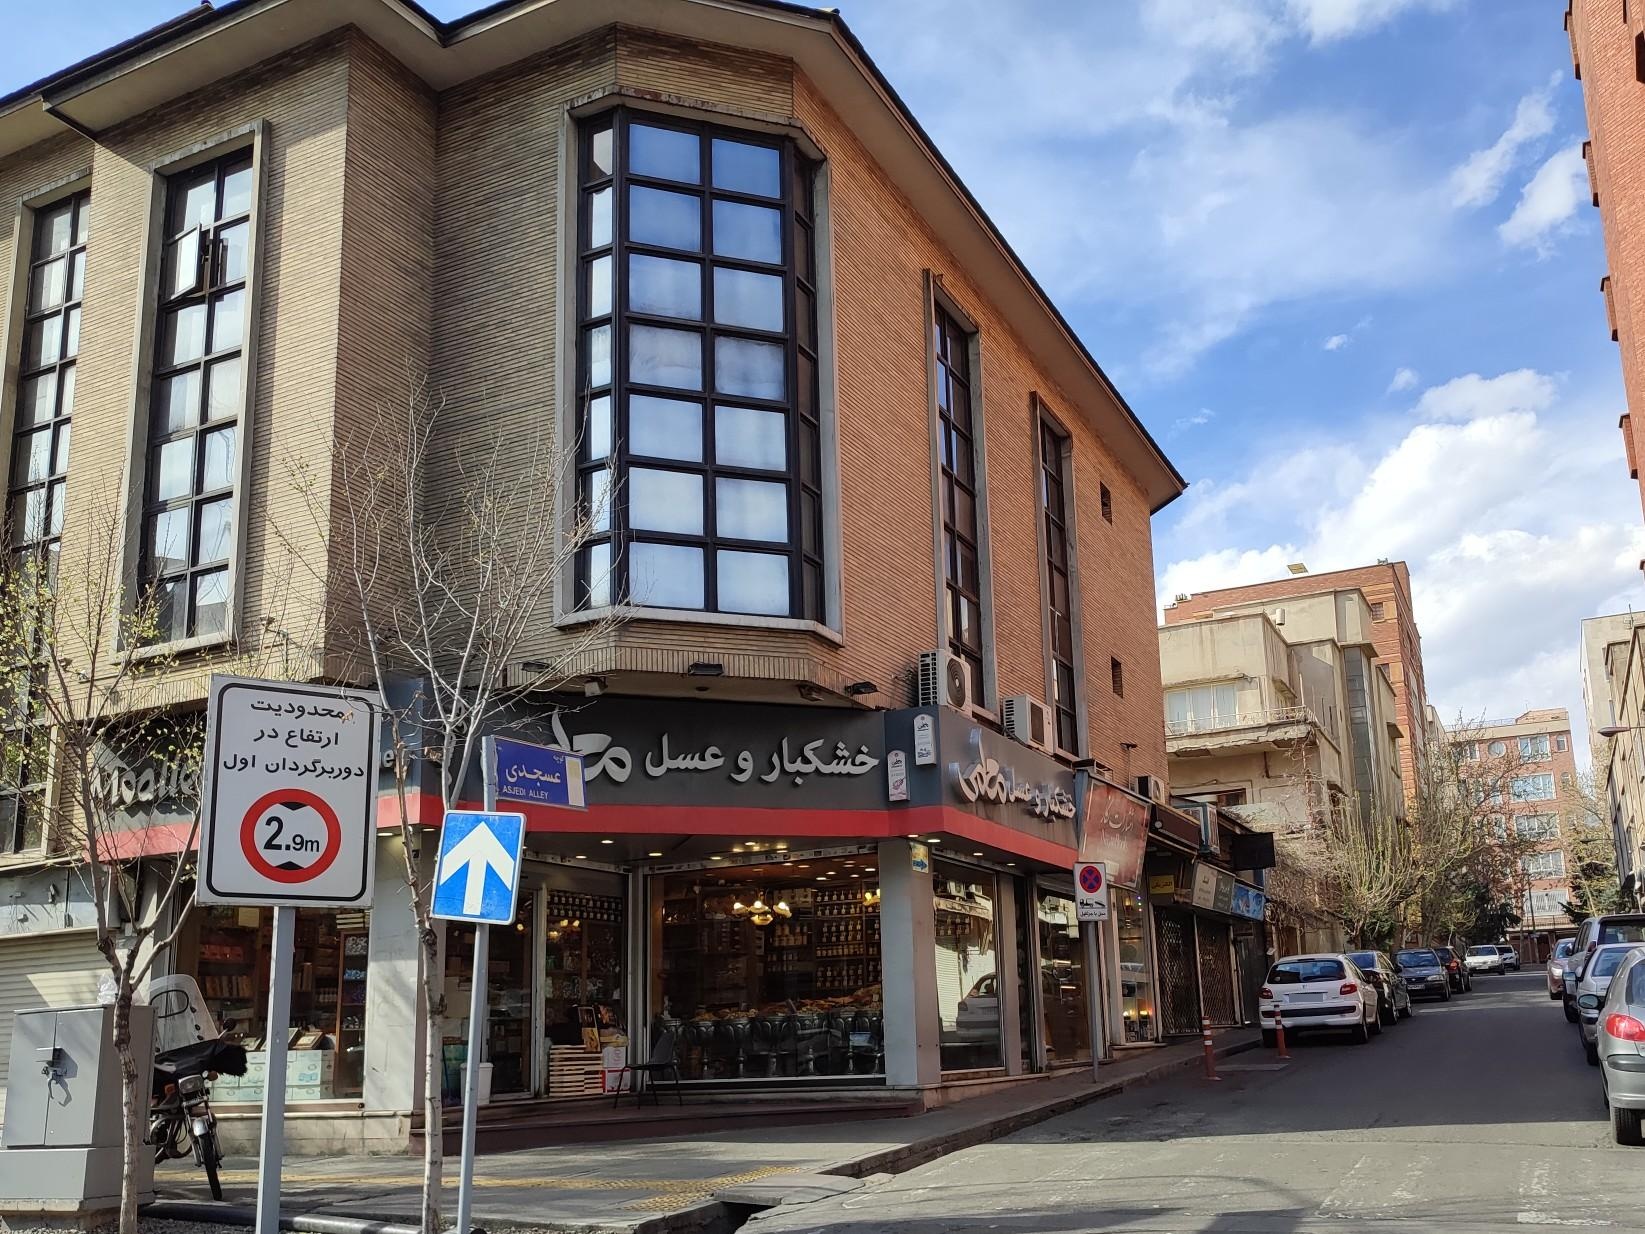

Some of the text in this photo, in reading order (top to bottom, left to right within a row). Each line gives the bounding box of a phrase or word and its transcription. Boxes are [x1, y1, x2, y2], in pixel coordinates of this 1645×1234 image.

[254, 726, 339, 748] ارتفاع در
[223, 753, 256, 771] اول
[645, 733, 726, 777] عسل
[760, 735, 880, 786] خشکبار
[265, 757, 363, 779] دوربرگردان
[506, 764, 561, 786] عسجدی
[729, 751, 754, 783] و
[502, 785, 549, 799] ASJEDI ALLEY
